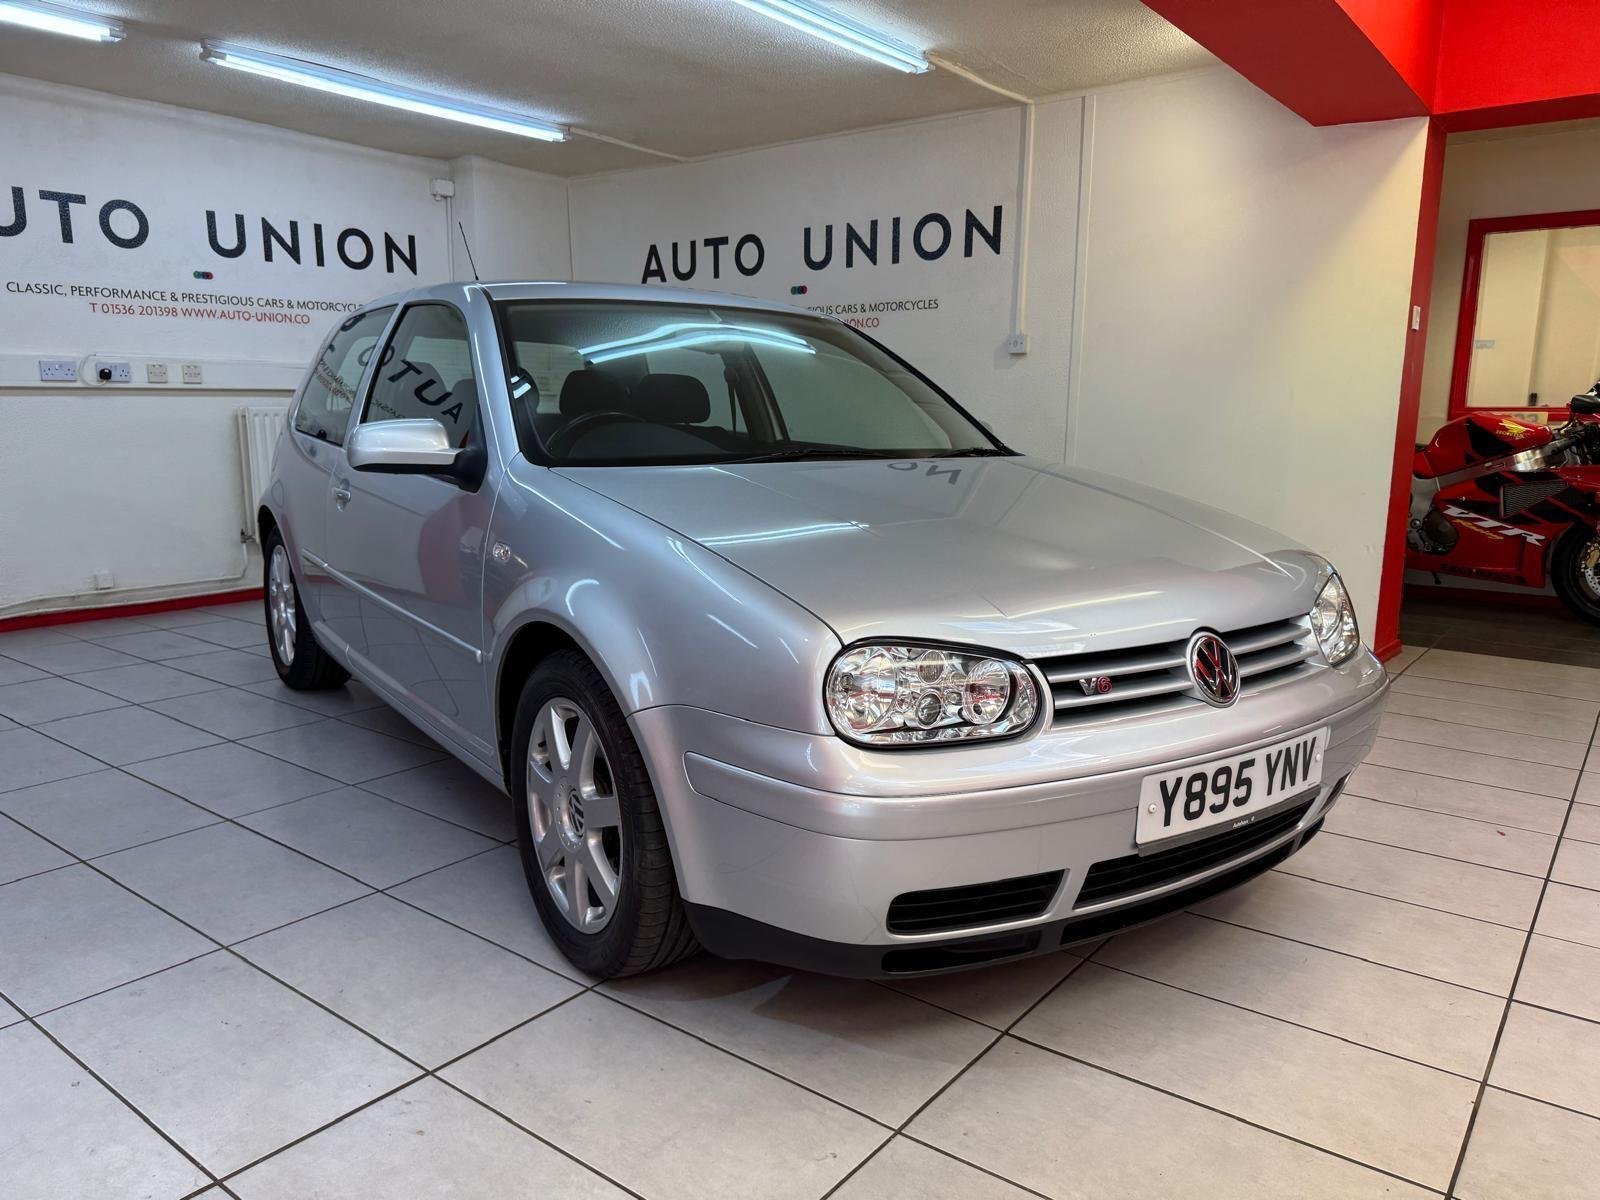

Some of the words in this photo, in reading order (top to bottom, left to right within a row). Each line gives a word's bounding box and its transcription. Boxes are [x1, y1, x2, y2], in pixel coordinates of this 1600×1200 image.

[0, 186, 149, 249] UTO
[205, 210, 418, 276] UNION
[641, 233, 765, 284] AUTO
[803, 205, 1002, 271] UNION
[6, 281, 67, 297] CLASSIC,
[70, 285, 167, 302] PERFORMANCE
[170, 292, 179, 302] &
[181, 292, 254, 307] PRESTIGIOUS
[257, 298, 284, 309] CARS
[287, 301, 294, 310] &
[296, 301, 363, 313] MOTORCYC
[835, 304, 858, 315] CARS
[860, 303, 867, 314] &
[869, 299, 939, 313] MOTORCYCLES
[89, 302, 98, 313] T
[101, 303, 135, 316] 01536
[138, 306, 178, 317] 201398
[181, 308, 311, 325] WWW.AUTO-UNION.CO
[1079, 676, 1113, 696] V6
[1159, 758, 1256, 828] Y895
[1265, 736, 1317, 797] YNV
